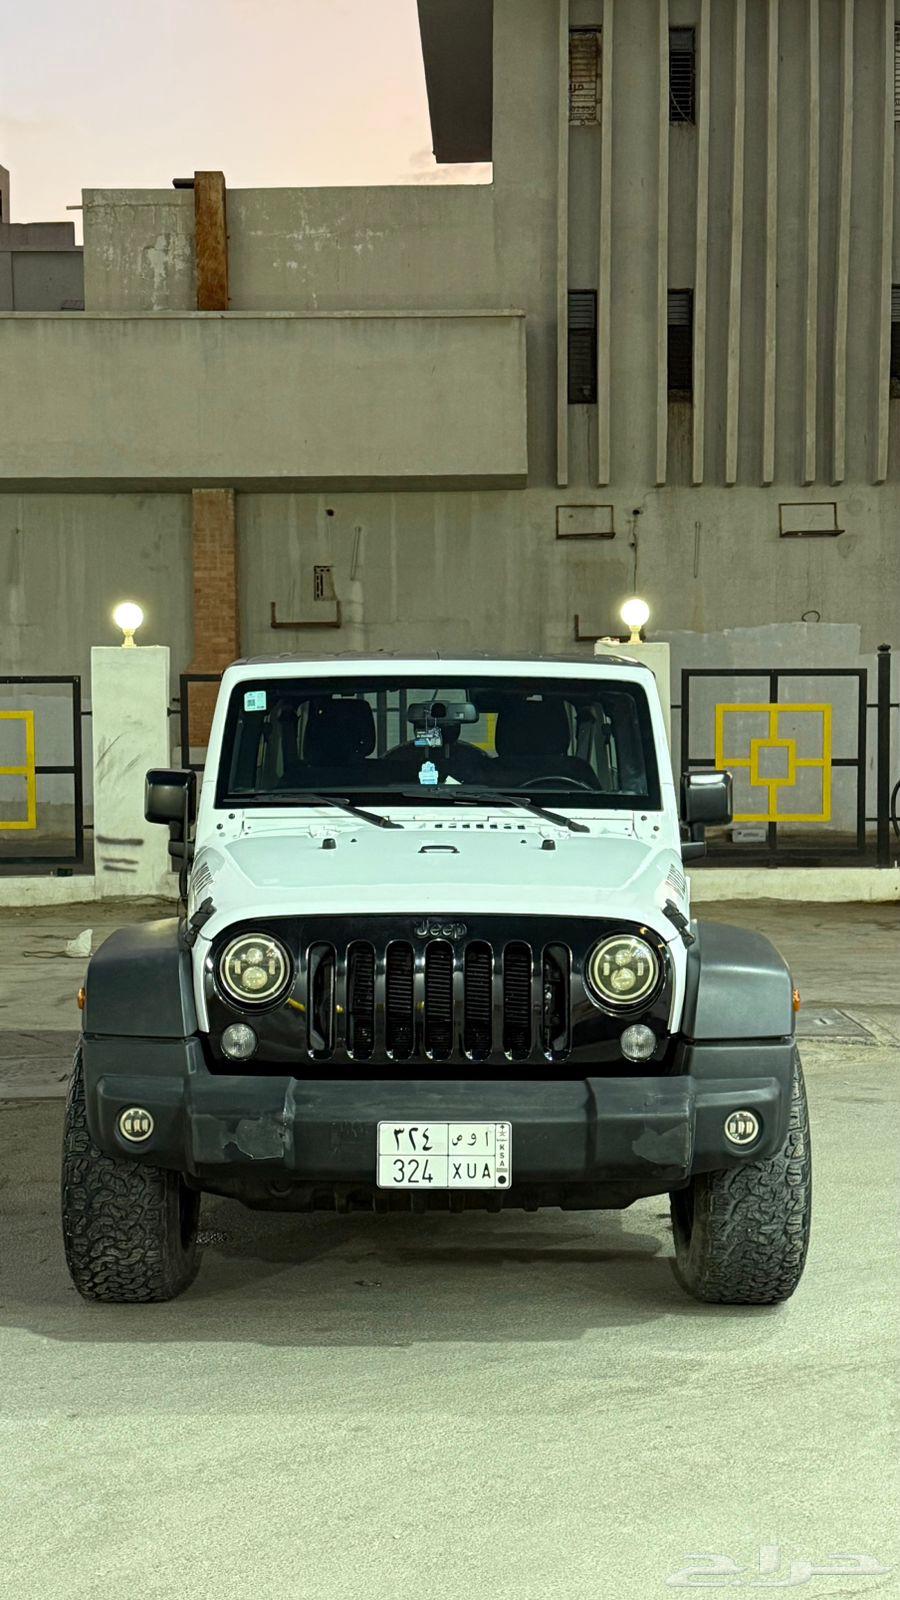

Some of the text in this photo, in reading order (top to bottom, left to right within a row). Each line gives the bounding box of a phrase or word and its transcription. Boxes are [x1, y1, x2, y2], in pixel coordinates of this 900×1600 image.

[414, 919, 468, 940] Jeep
[393, 1127, 433, 1152] ٣٢٤
[498, 1144, 506, 1167] KSA
[392, 1158, 434, 1184] 324
[452, 1162, 492, 1180] XUA
